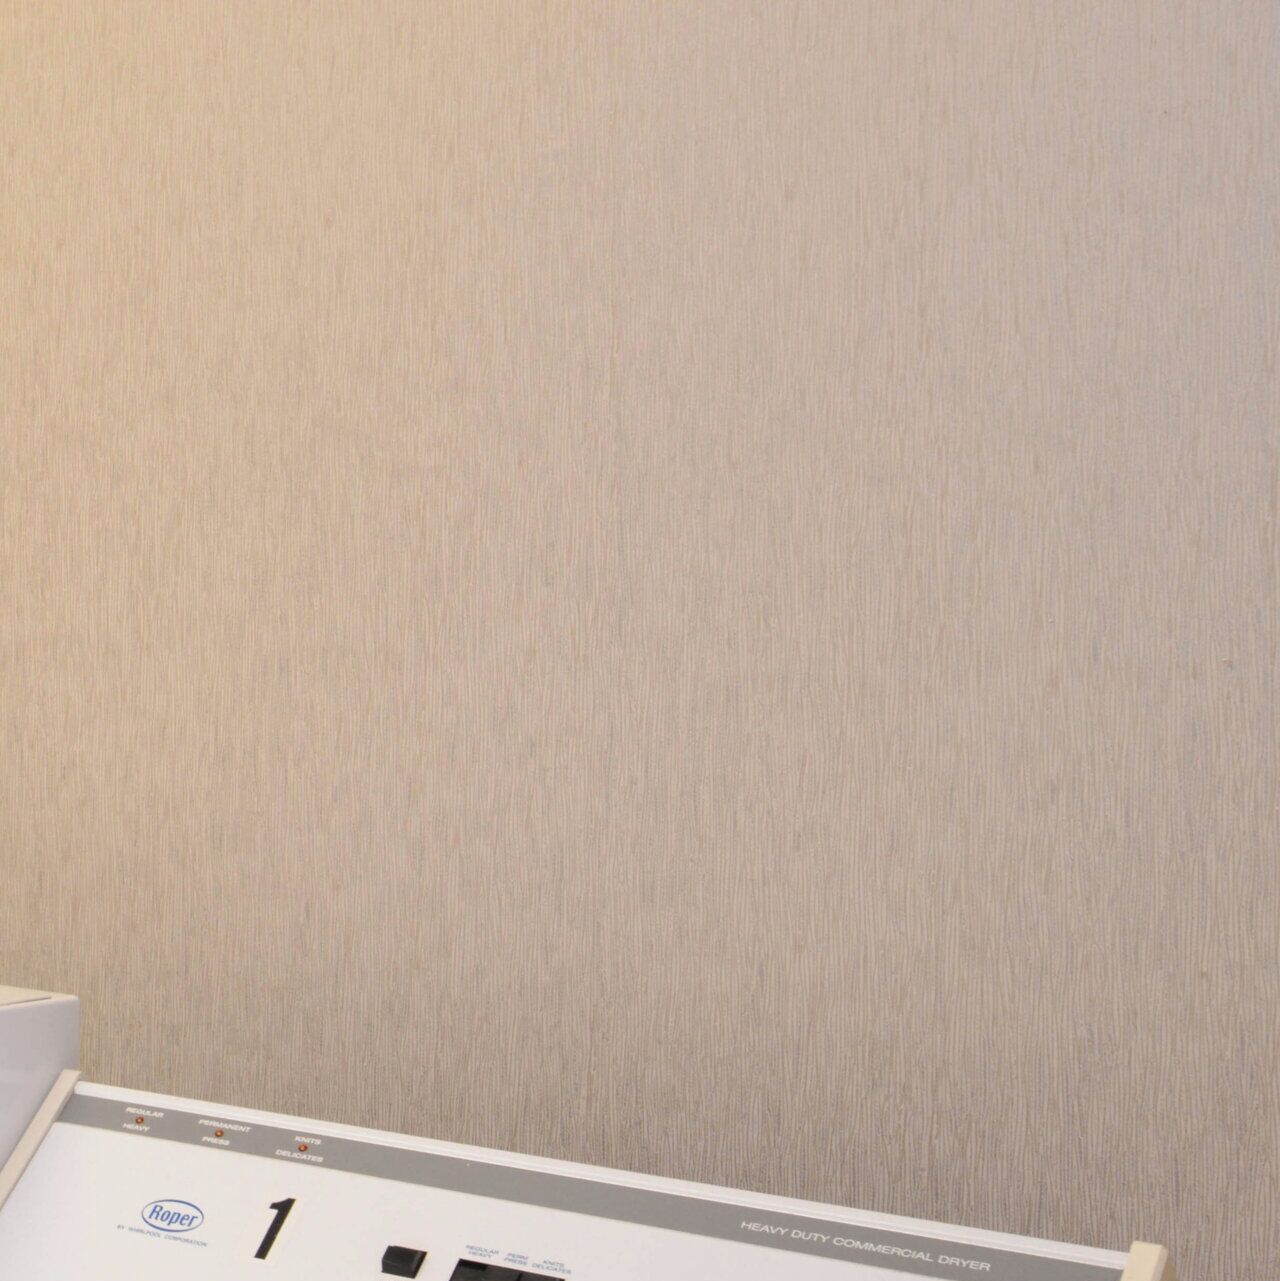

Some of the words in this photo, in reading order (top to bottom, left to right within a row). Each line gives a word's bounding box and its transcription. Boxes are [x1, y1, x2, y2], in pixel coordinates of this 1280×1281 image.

[125, 1106, 164, 1118] REGULAR
[122, 1122, 150, 1132] HEAVY
[198, 1119, 251, 1133] PERMANENT
[201, 1136, 230, 1146] PRESS
[294, 1135, 322, 1145] KNITS
[275, 1149, 324, 1163] DELICATES
[148, 1204, 198, 1227] Roper
[254, 1197, 297, 1260] 1
[740, 1221, 789, 1236] HEAVY
[791, 1229, 830, 1243] DUTY
[833, 1237, 934, 1262] COMMERCIAL
[938, 1255, 991, 1272] DRYER
